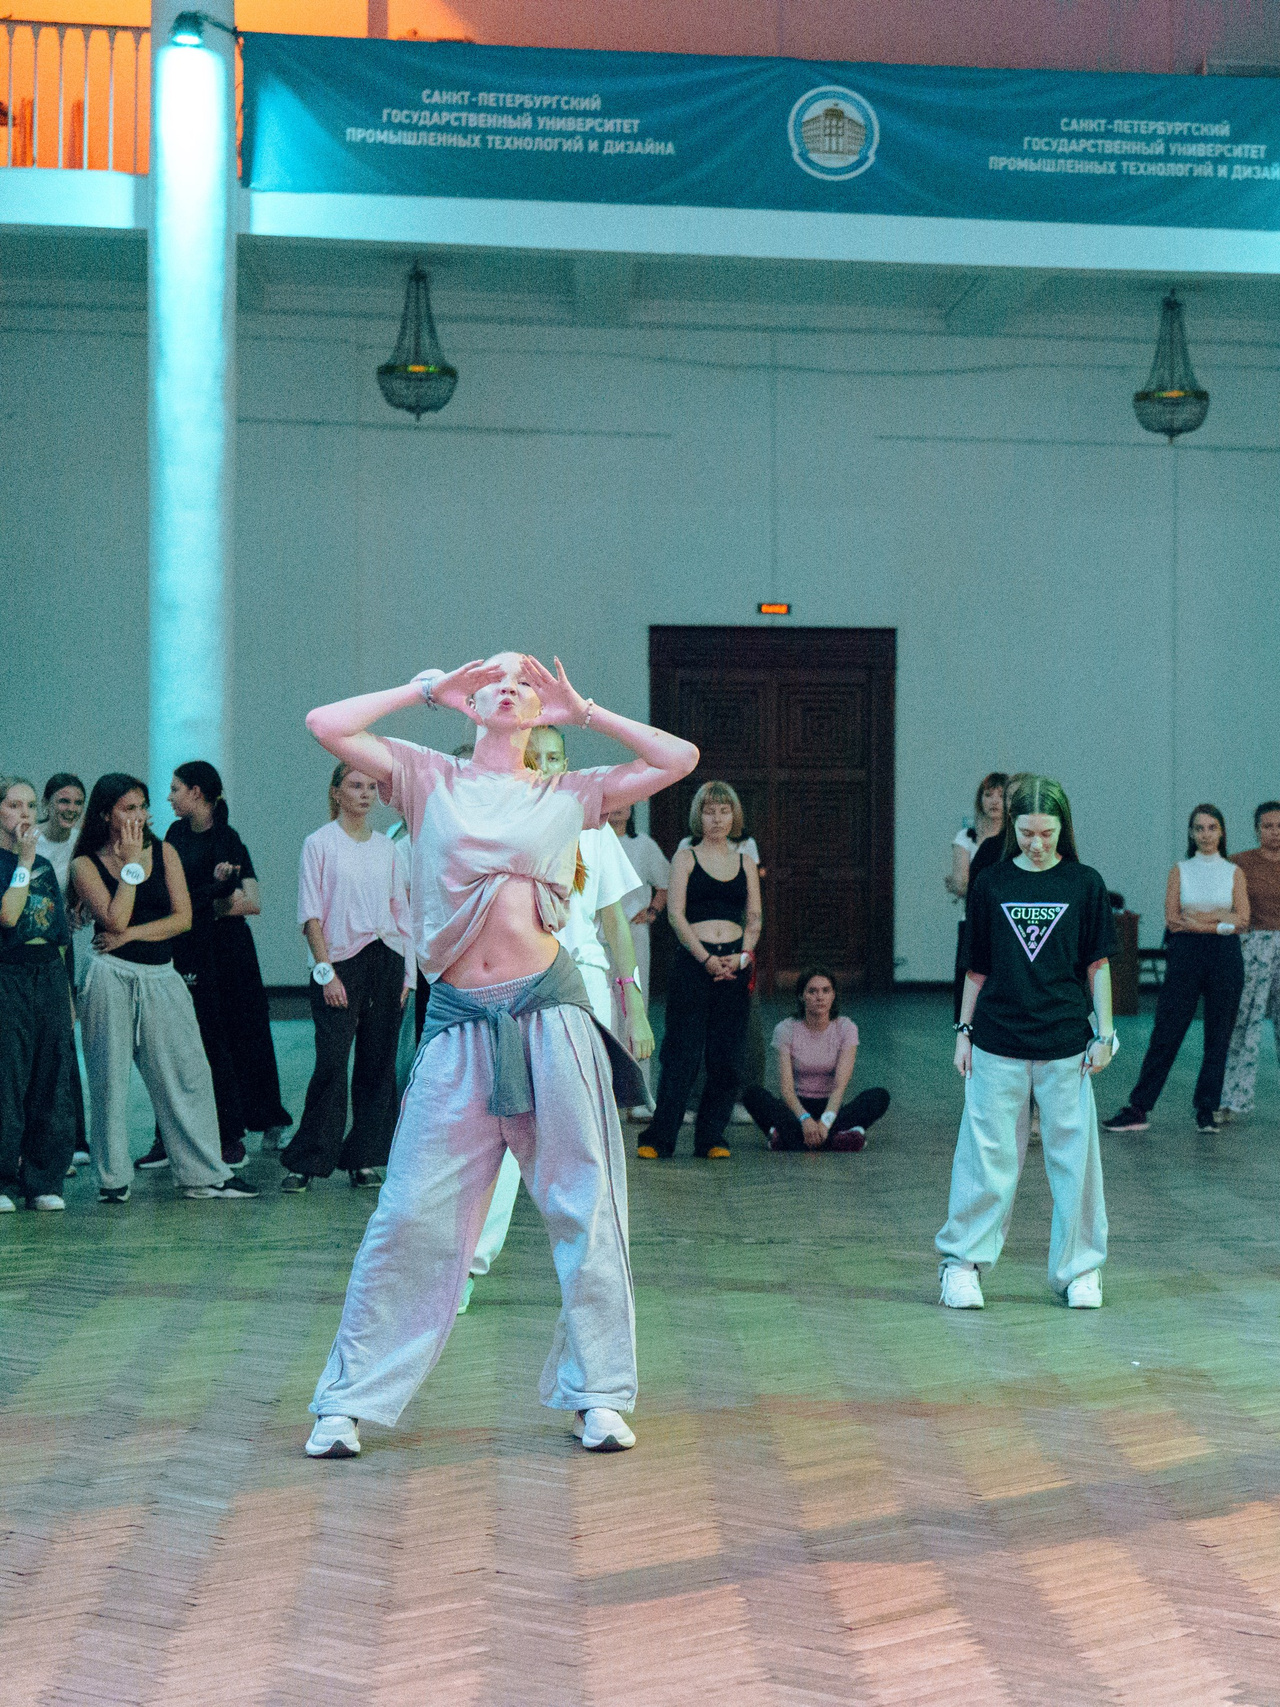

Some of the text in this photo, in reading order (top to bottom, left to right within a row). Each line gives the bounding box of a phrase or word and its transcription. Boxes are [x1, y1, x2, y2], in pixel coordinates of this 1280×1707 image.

[421, 89, 602, 111] САНКТ-ПЕТЕРБУРГСКИЙ
[382, 108, 641, 134] ГОСУДАРСТВЕННЫЙ УНИВЕРСИТЕТ
[1060, 117, 1231, 137] САНКТ-ПЕТЕРБУРГСКИЙ
[345, 127, 675, 156] ПРОМЫШЛЕННЫХ ТЕХНОЛОГИЙ И ДИЗАЙНА
[1023, 136, 1268, 159] ГОСУДАРСТВЕННЫЙ УНИВЕРСИТЕТ
[988, 155, 1117, 175] ПРОМЫШЛЕННЫХ
[1121, 161, 1214, 178] ТЕХНОЛОГИЙ
[1217, 164, 1228, 178] И
[1010, 907, 1056, 920] GUESS
